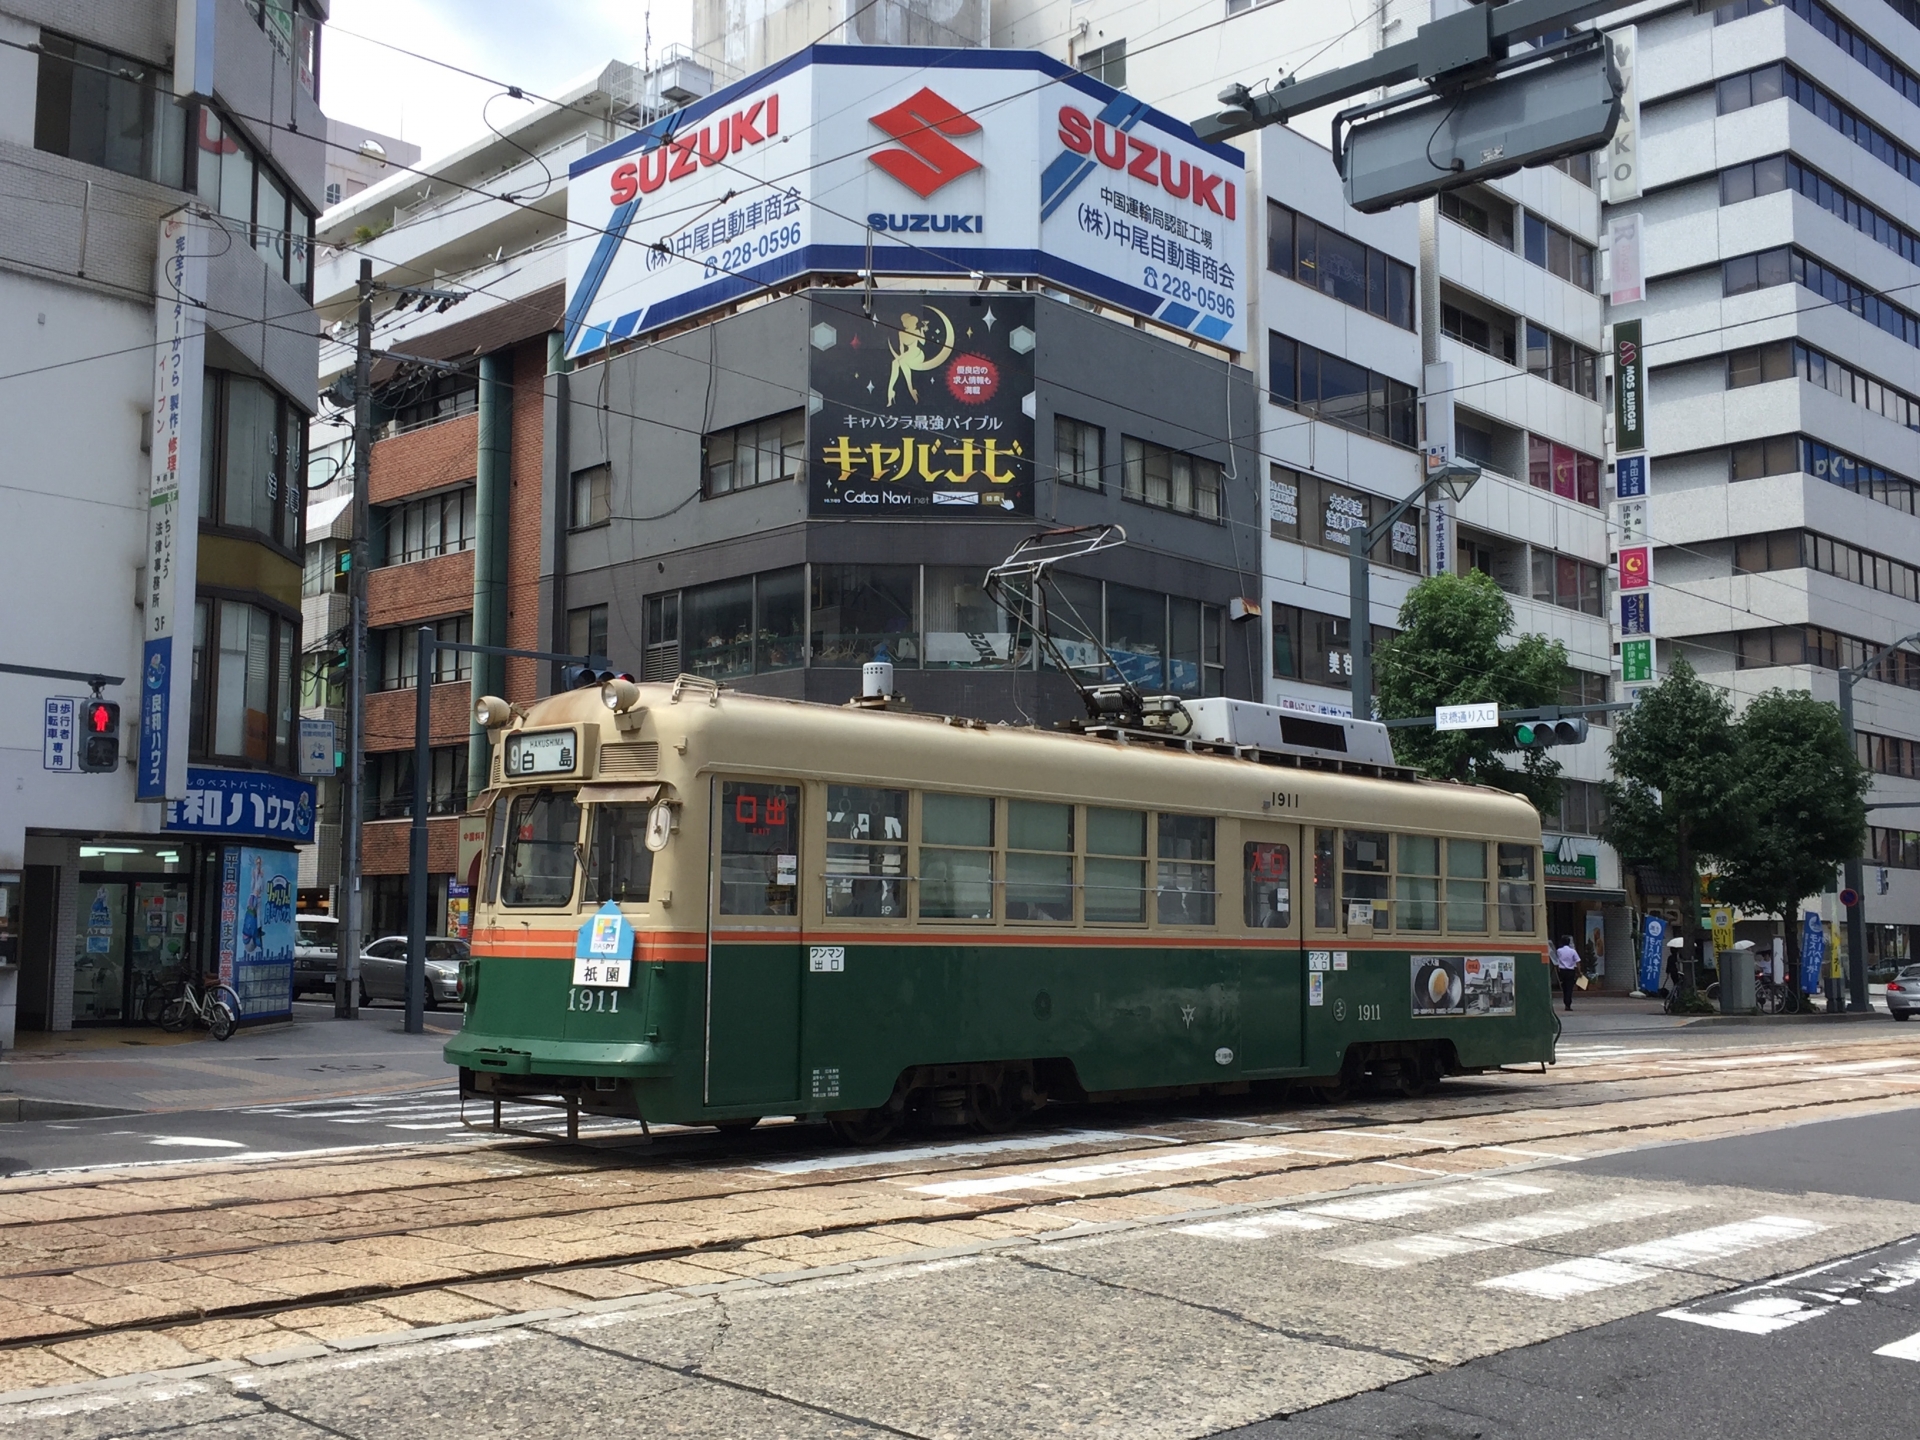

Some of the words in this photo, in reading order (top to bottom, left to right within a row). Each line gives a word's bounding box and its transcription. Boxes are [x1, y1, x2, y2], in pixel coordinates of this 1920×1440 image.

[611, 93, 779, 206] SUZUKI
[1058, 105, 1236, 221] SUZUKI
[645, 187, 801, 272] (株)中尾自動車商会
[867, 212, 983, 234] SUZUKI
[1100, 187, 1213, 250] 中国運輸局認証工場
[722, 222, 801, 272] 228-0596
[1077, 202, 1236, 291] (株)中尾自動車商会
[1162, 273, 1236, 319] 228-0596
[953, 375, 992, 386] 求人情報も
[956, 365, 988, 375] 優良店の
[1626, 365, 1635, 389] MOS
[964, 386, 981, 396] 満載
[843, 414, 1004, 431] キャバクラ最強バイブル
[1627, 391, 1636, 432] BURGER
[822, 436, 1024, 484] キャバナビ
[844, 490, 879, 505] Caba
[1623, 505, 1631, 541] 法律事務所
[152, 522, 164, 608] 法律事務所
[154, 616, 165, 632] 3F
[47, 702, 58, 739] 自転車
[59, 703, 71, 740] 歩行者
[1439, 709, 1495, 725] 京橋通り入口
[150, 693, 162, 786] 良和ハウス
[530, 737, 564, 749] HAKUSHIMA
[52, 742, 63, 766] 専用
[510, 745, 519, 770] 9
[522, 747, 573, 771] 白島
[1272, 791, 1299, 808] 1911
[1545, 864, 1560, 875] MOS
[1561, 865, 1586, 876] BURGER
[593, 942, 615, 950] PASPY
[811, 948, 844, 958] ワンマン
[1309, 952, 1329, 961] ワンマン
[815, 959, 839, 970] 出口
[1311, 961, 1328, 969] 入口
[1646, 937, 1656, 980] モスバーガー
[584, 965, 620, 983] 祇園
[567, 988, 619, 1013] 1911
[1358, 1004, 1381, 1021] 1911
